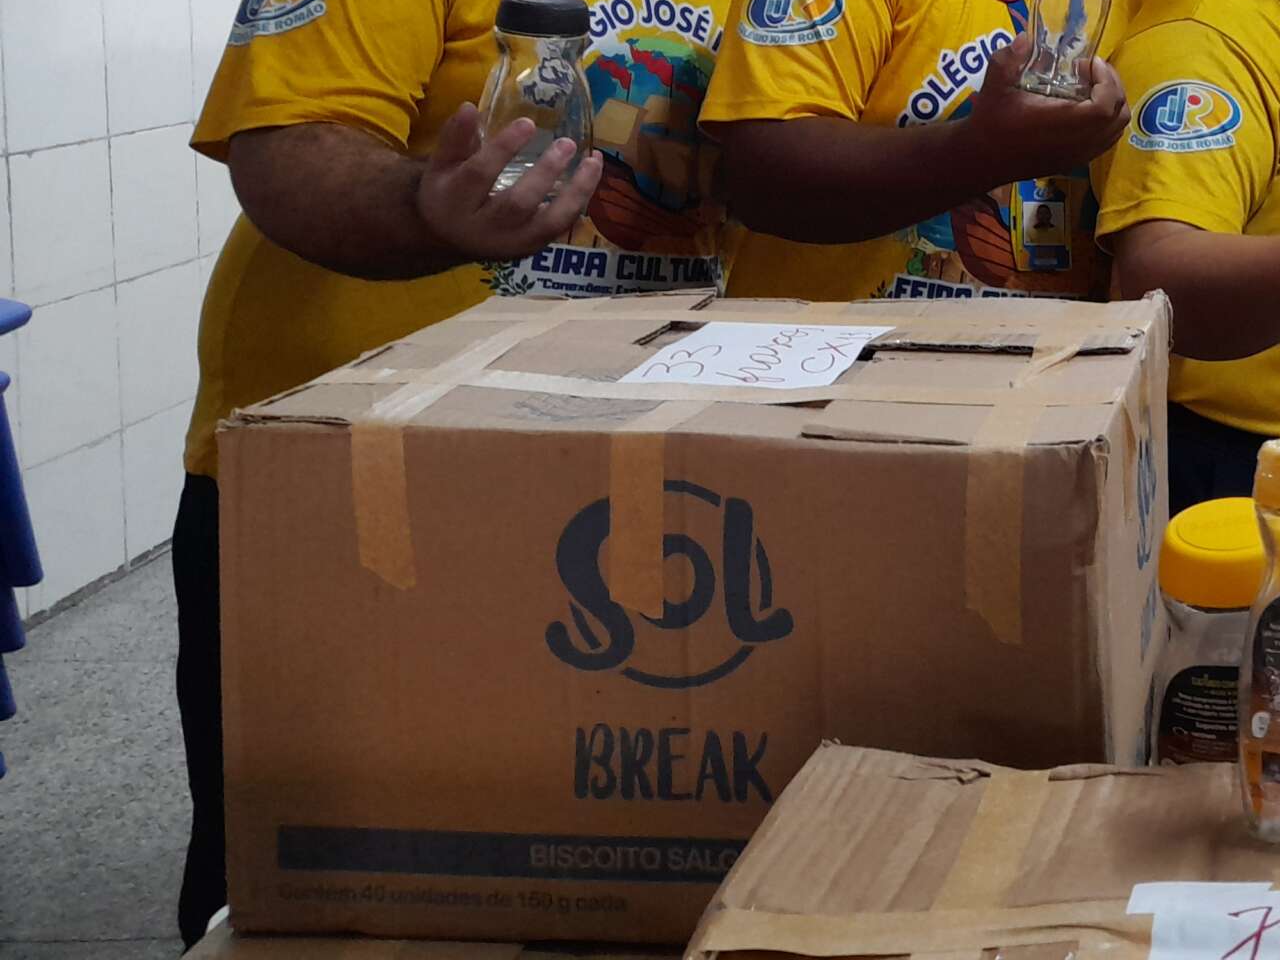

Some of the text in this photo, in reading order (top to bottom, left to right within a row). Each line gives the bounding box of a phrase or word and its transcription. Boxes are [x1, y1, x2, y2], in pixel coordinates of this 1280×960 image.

[511, 247, 608, 278] EIRA
[574, 724, 773, 803] BREAK
[529, 843, 661, 872] BISCOITO
